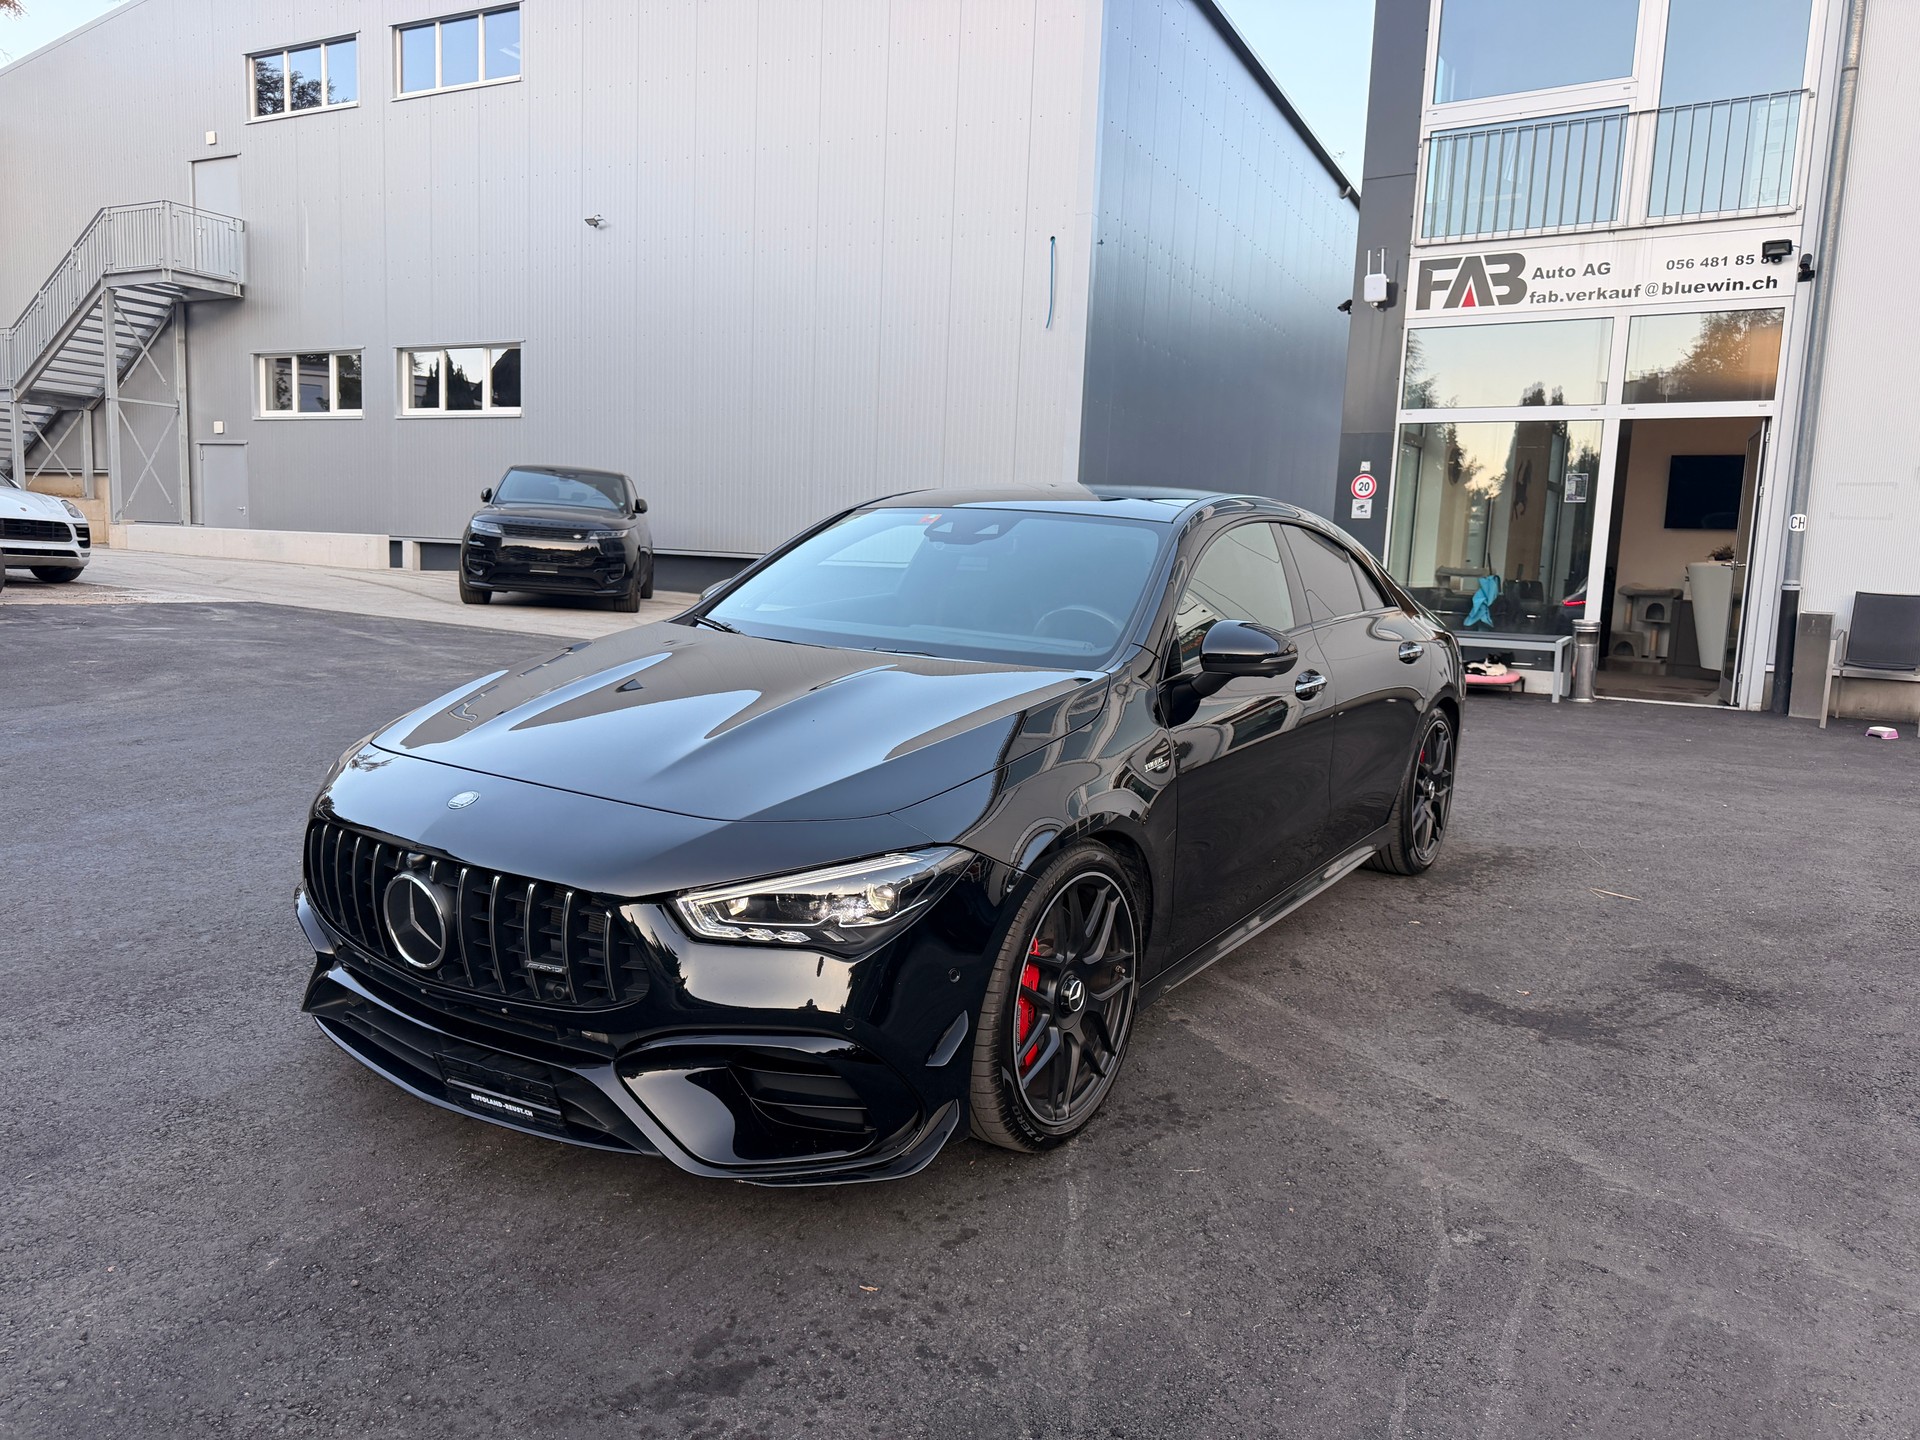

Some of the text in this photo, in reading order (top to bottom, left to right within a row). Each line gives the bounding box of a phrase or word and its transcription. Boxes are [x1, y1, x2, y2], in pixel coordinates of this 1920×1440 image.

[1666, 259, 1695, 270] 056
[1700, 256, 1728, 268] 481
[1735, 254, 1755, 266] 85
[1532, 262, 1611, 280] Auto AG
[1416, 253, 1527, 310] FAB
[1358, 481, 1370, 492] 20
[1791, 516, 1806, 529] CH
